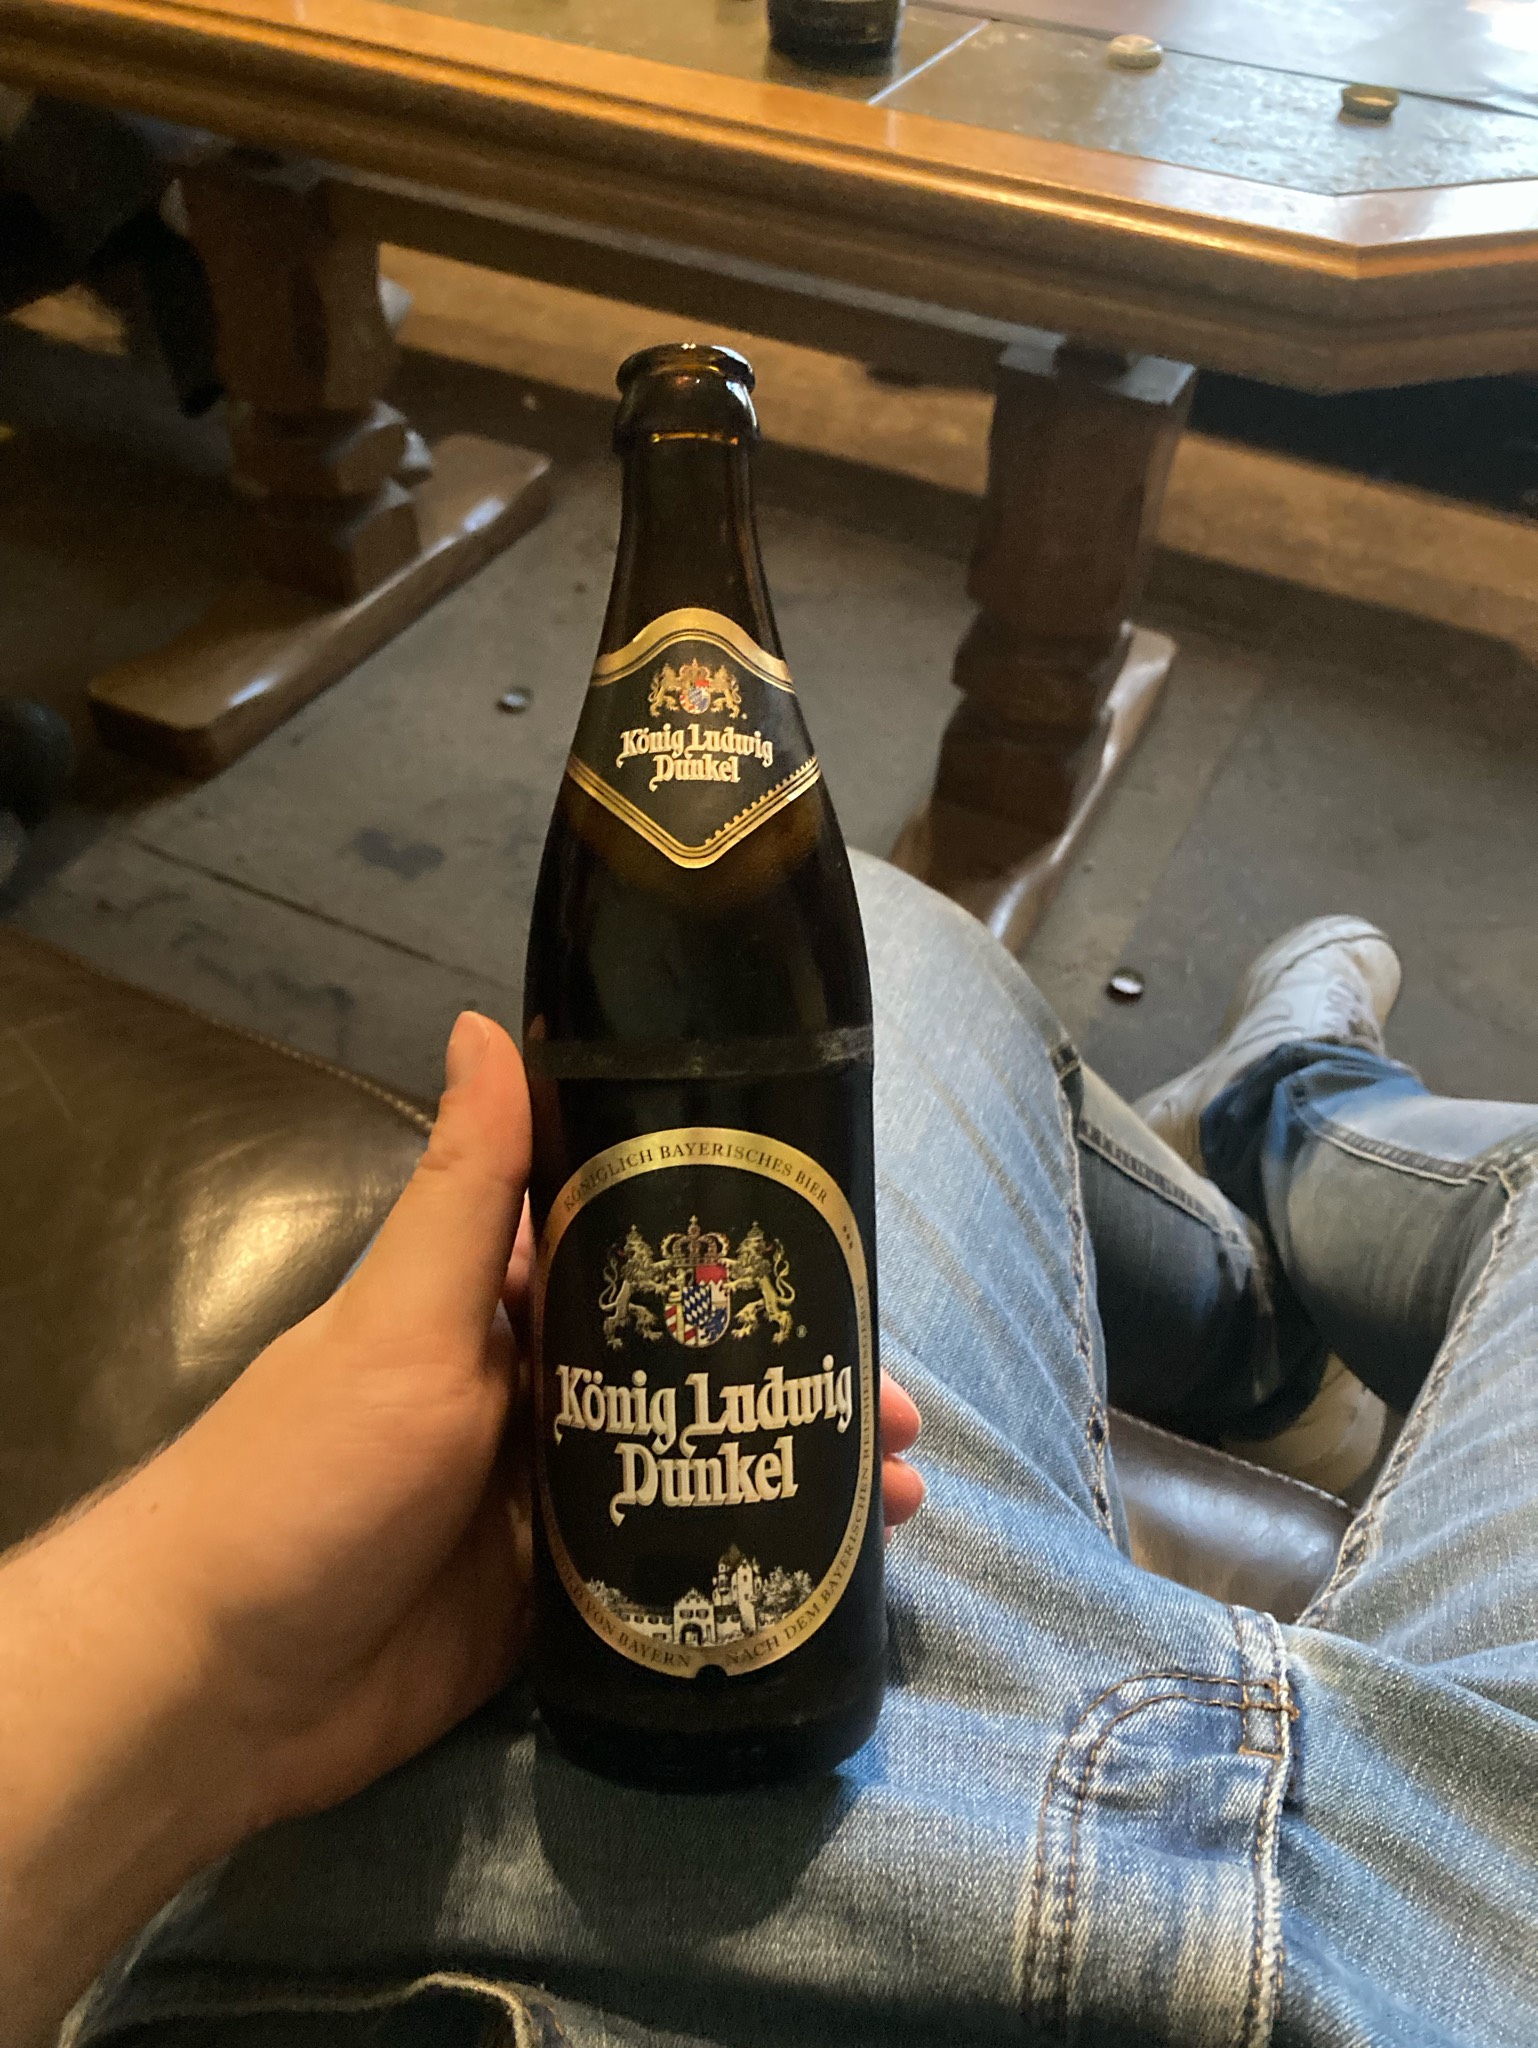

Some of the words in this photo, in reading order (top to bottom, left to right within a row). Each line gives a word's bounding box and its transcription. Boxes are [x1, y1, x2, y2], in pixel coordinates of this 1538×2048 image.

[616, 723, 684, 768] König
[685, 724, 773, 767] Ludwig
[649, 754, 740, 792] Dunkel
[564, 1149, 653, 1212] KÖNIGLICH
[660, 1142, 792, 1176] BAYERISCHES
[794, 1170, 827, 1204] BIER
[554, 1364, 676, 1455] König
[679, 1354, 852, 1458] Ludwig
[610, 1436, 798, 1527] Dunkel
[617, 1631, 691, 1668] BAYERN
[726, 1635, 780, 1665] NACH
[784, 1602, 821, 1641] DEM
